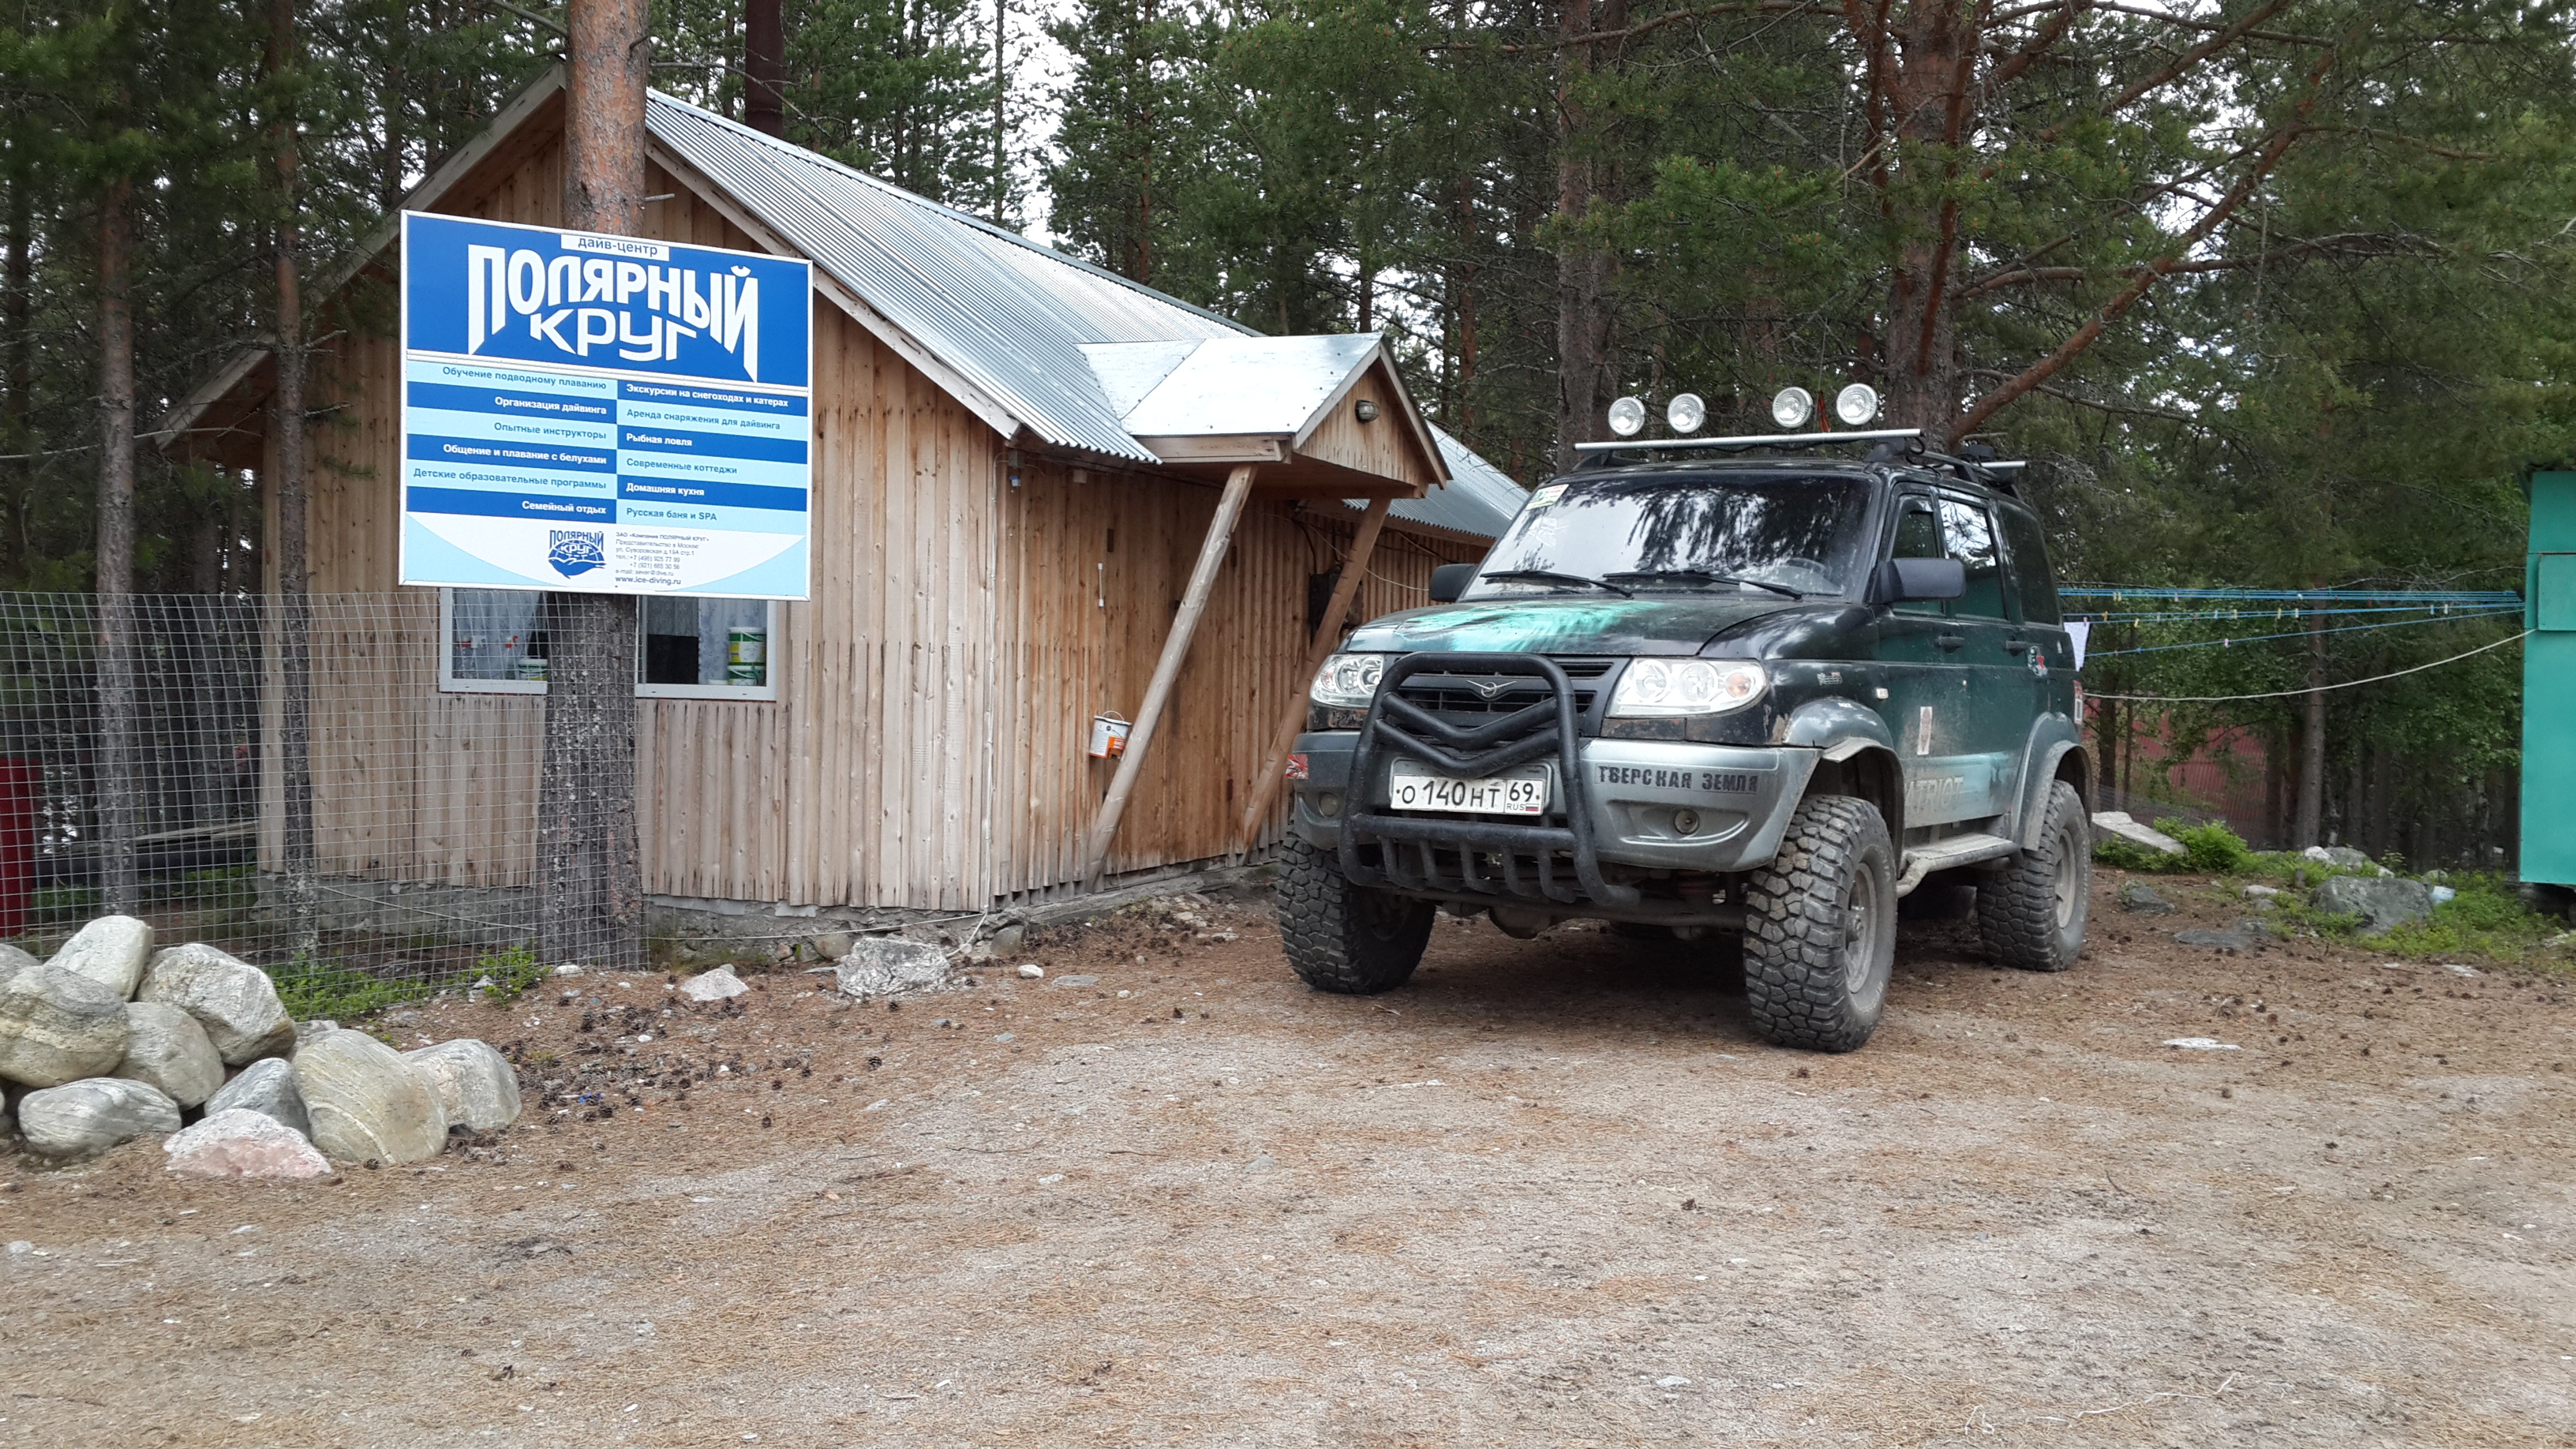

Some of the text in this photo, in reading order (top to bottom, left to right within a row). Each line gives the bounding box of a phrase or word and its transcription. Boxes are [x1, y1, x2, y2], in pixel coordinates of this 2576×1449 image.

[578, 238, 658, 257] дайв-центр
[468, 244, 758, 383] ПОЛЯРНЫЙ
[530, 309, 697, 361] КРУГ
[443, 366, 606, 390] Обучение подводному плаванию
[495, 396, 607, 414] Организация дайвинга
[627, 384, 676, 397] Экскурсии
[692, 391, 743, 403] снегоходах
[754, 397, 788, 407] катерах
[627, 409, 661, 420] Аренда
[664, 413, 719, 425] снаряжения
[740, 420, 780, 430] дайвинга
[494, 422, 606, 440] Опытные инструкторы
[626, 433, 692, 447] Рыбная ловля
[444, 444, 491, 455] Общение
[503, 450, 549, 460] плавание
[560, 452, 607, 465] белухами
[627, 458, 737, 474] Современные коттеджи
[414, 468, 606, 489] Детские образовательные программы
[626, 482, 704, 496] Домашняя кухня
[522, 500, 606, 515] Семейный отдых
[627, 507, 664, 518] Русская
[666, 509, 688, 519] баня
[698, 511, 717, 521] SPA
[549, 530, 604, 552] ПОЛЯРНЫЙ
[560, 544, 593, 554] КРУГ
[616, 539, 671, 548] Представительство
[615, 576, 681, 586] www.ice-diving.ru
[1597, 766, 1758, 792] ТВЕРСКАЯ ЗЕМЛЯ
[1509, 781, 1534, 803] 69
[1904, 777, 1964, 816] ATRIOT
